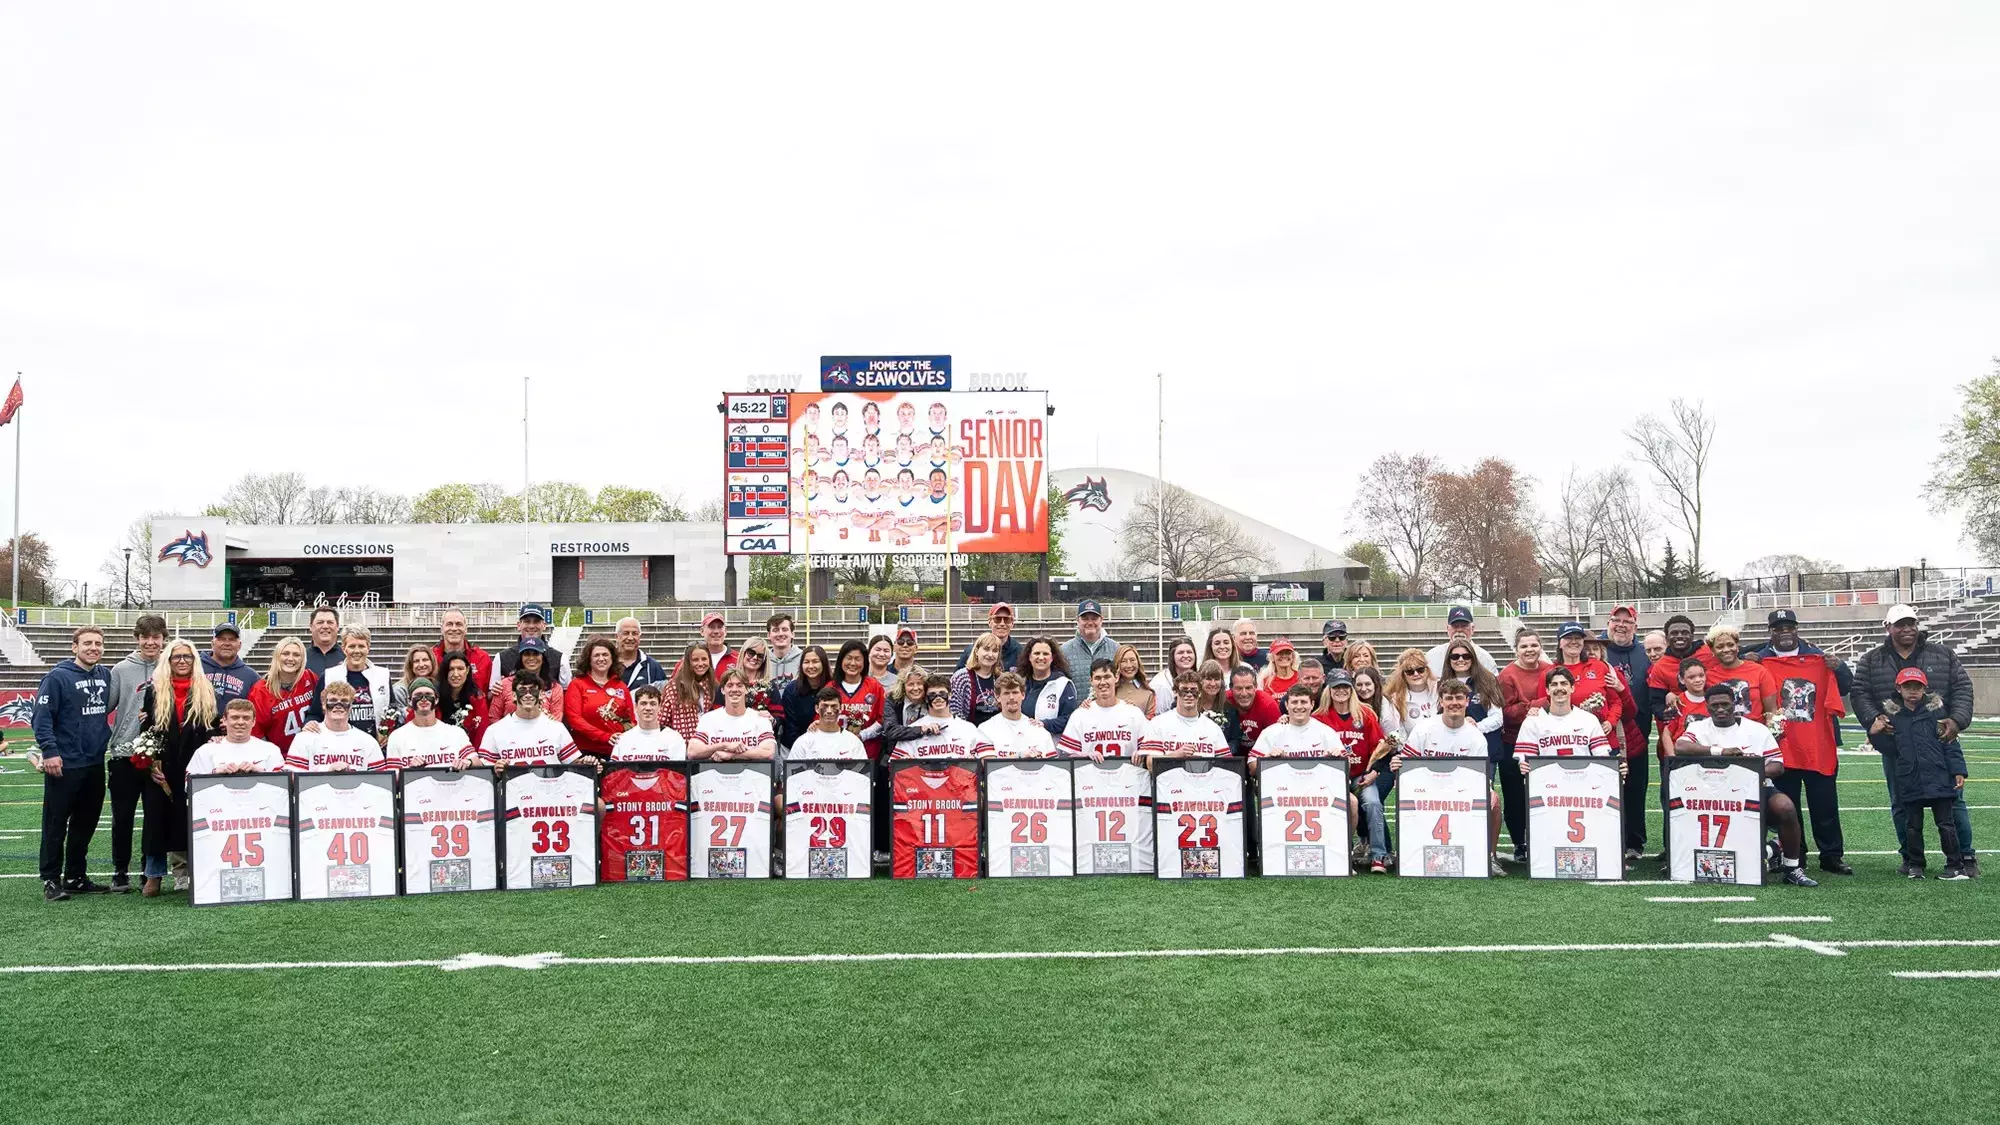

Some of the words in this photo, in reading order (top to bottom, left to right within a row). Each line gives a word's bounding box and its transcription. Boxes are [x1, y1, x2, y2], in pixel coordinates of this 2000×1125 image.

[870, 361, 898, 370] HOME
[898, 361, 911, 370] OF
[911, 361, 932, 370] THE
[746, 374, 802, 390] STONY
[855, 371, 946, 387] SEAWOLVES
[969, 372, 1028, 390] BROOK
[731, 402, 768, 413] 45:22
[776, 406, 783, 414] 1
[762, 425, 770, 434] 0
[960, 418, 1043, 459] SENIOR
[762, 475, 770, 483] 0
[963, 460, 1043, 534] DAY
[303, 545, 394, 555] CONCESSIONS
[550, 543, 631, 553] RESTROOMS
[740, 538, 777, 551] CAA
[809, 555, 847, 569] KEHOE
[847, 555, 888, 568] FAMILY
[891, 553, 970, 568] SCOREBOARD
[1254, 594, 1286, 602] SEAWOLVES
[38, 695, 50, 705] 45
[1084, 730, 1132, 743] SEAWOLVES
[1539, 734, 1589, 749] SEAWOLVES
[502, 745, 555, 760] SEAWOLVES
[917, 744, 966, 757] SEAWOLVES
[617, 801, 643, 812] STONY
[645, 801, 672, 812] BROOK
[703, 801, 755, 813] SEAWOLVES
[802, 802, 855, 814] SEAWOLVES
[907, 799, 933, 810] STONY
[935, 799, 962, 810] BROOK
[1003, 798, 1056, 810] SEAWOLVES
[1084, 796, 1136, 808] SEAWOLVES
[1172, 800, 1225, 812] SEAWOLVES
[1277, 796, 1329, 808] SEAWOLVES
[1415, 799, 1471, 813] SEAWOLVES
[1547, 795, 1604, 809] SEAWOLVES
[1686, 798, 1743, 812] SEAWOLVES
[422, 809, 478, 823] SEAWOLVES
[522, 806, 578, 819] SEAWOLVES
[211, 816, 272, 832] SEAWOLVES
[318, 817, 376, 829] SEAWOLVES
[629, 814, 660, 846] 31
[921, 813, 946, 844] 11
[1010, 811, 1048, 844] 26
[1095, 810, 1126, 842] 12
[1284, 809, 1322, 842] 25
[1431, 813, 1452, 846] 4
[1566, 809, 1586, 844] 5
[532, 820, 571, 854] 33
[710, 814, 747, 847] 27
[809, 816, 847, 848] 29
[1177, 813, 1219, 848] 23
[1697, 813, 1731, 849] 17
[430, 824, 470, 858] 39
[220, 832, 265, 868] 45
[326, 831, 370, 866] 40
